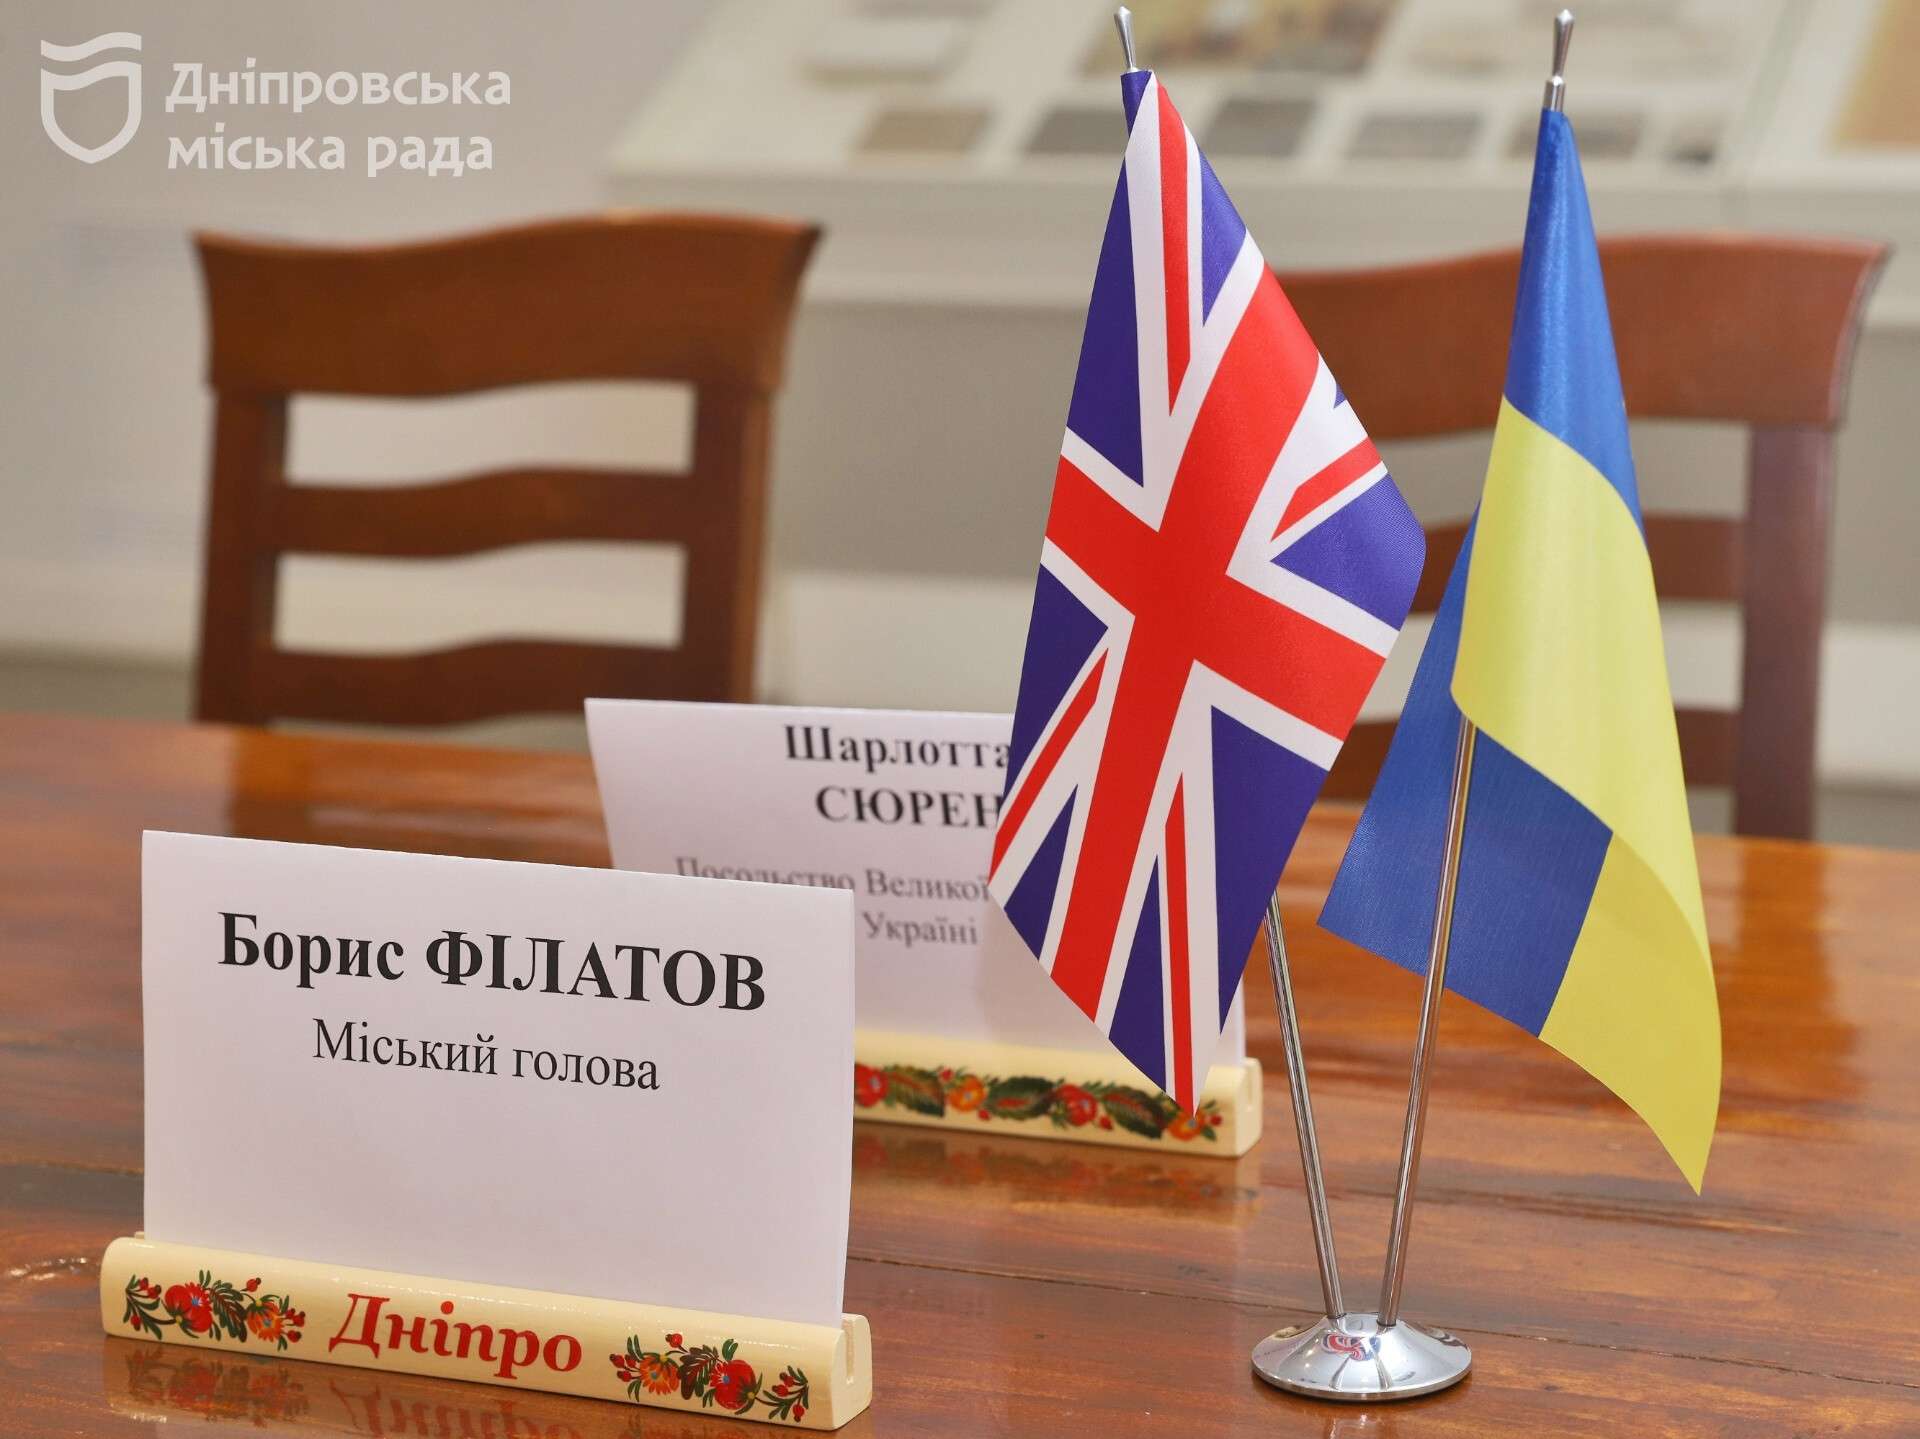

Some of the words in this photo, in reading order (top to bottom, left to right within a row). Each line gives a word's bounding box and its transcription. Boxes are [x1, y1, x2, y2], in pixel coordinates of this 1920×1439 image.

[785, 725, 1009, 774] Шарлотта
[864, 868, 990, 902] Великої
[861, 911, 979, 949] Україні
[218, 911, 405, 989] Борис
[426, 930, 766, 1011] ФІЛАТОВ
[312, 1018, 499, 1076] Міський
[511, 1048, 661, 1091] голова
[328, 1293, 583, 1380] Дніпро
